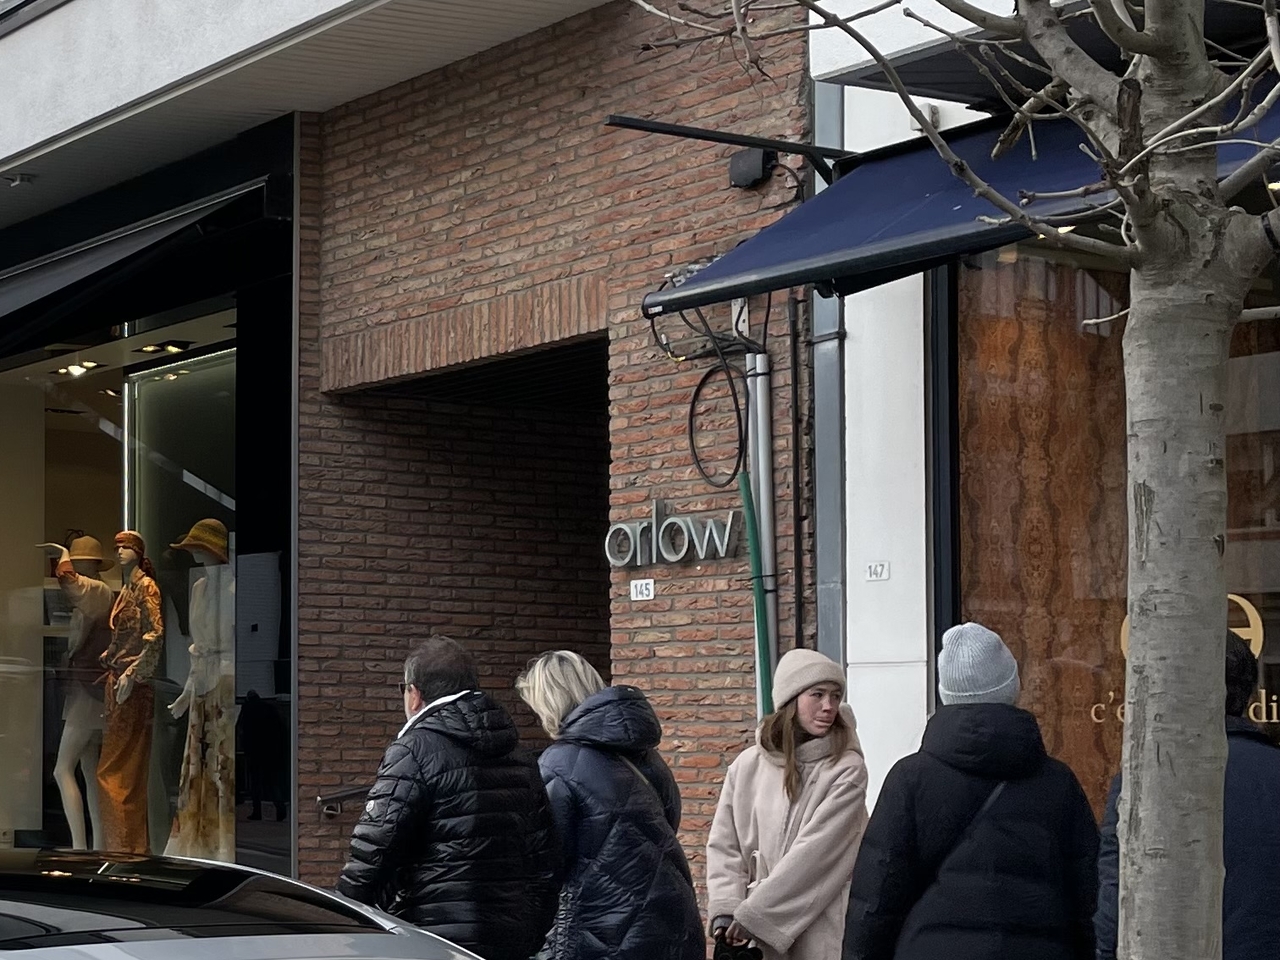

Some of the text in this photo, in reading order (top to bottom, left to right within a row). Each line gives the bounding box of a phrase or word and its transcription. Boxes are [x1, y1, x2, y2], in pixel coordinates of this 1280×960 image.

[605, 499, 734, 567] orlow
[867, 563, 885, 579] 147
[634, 582, 651, 599] 145
